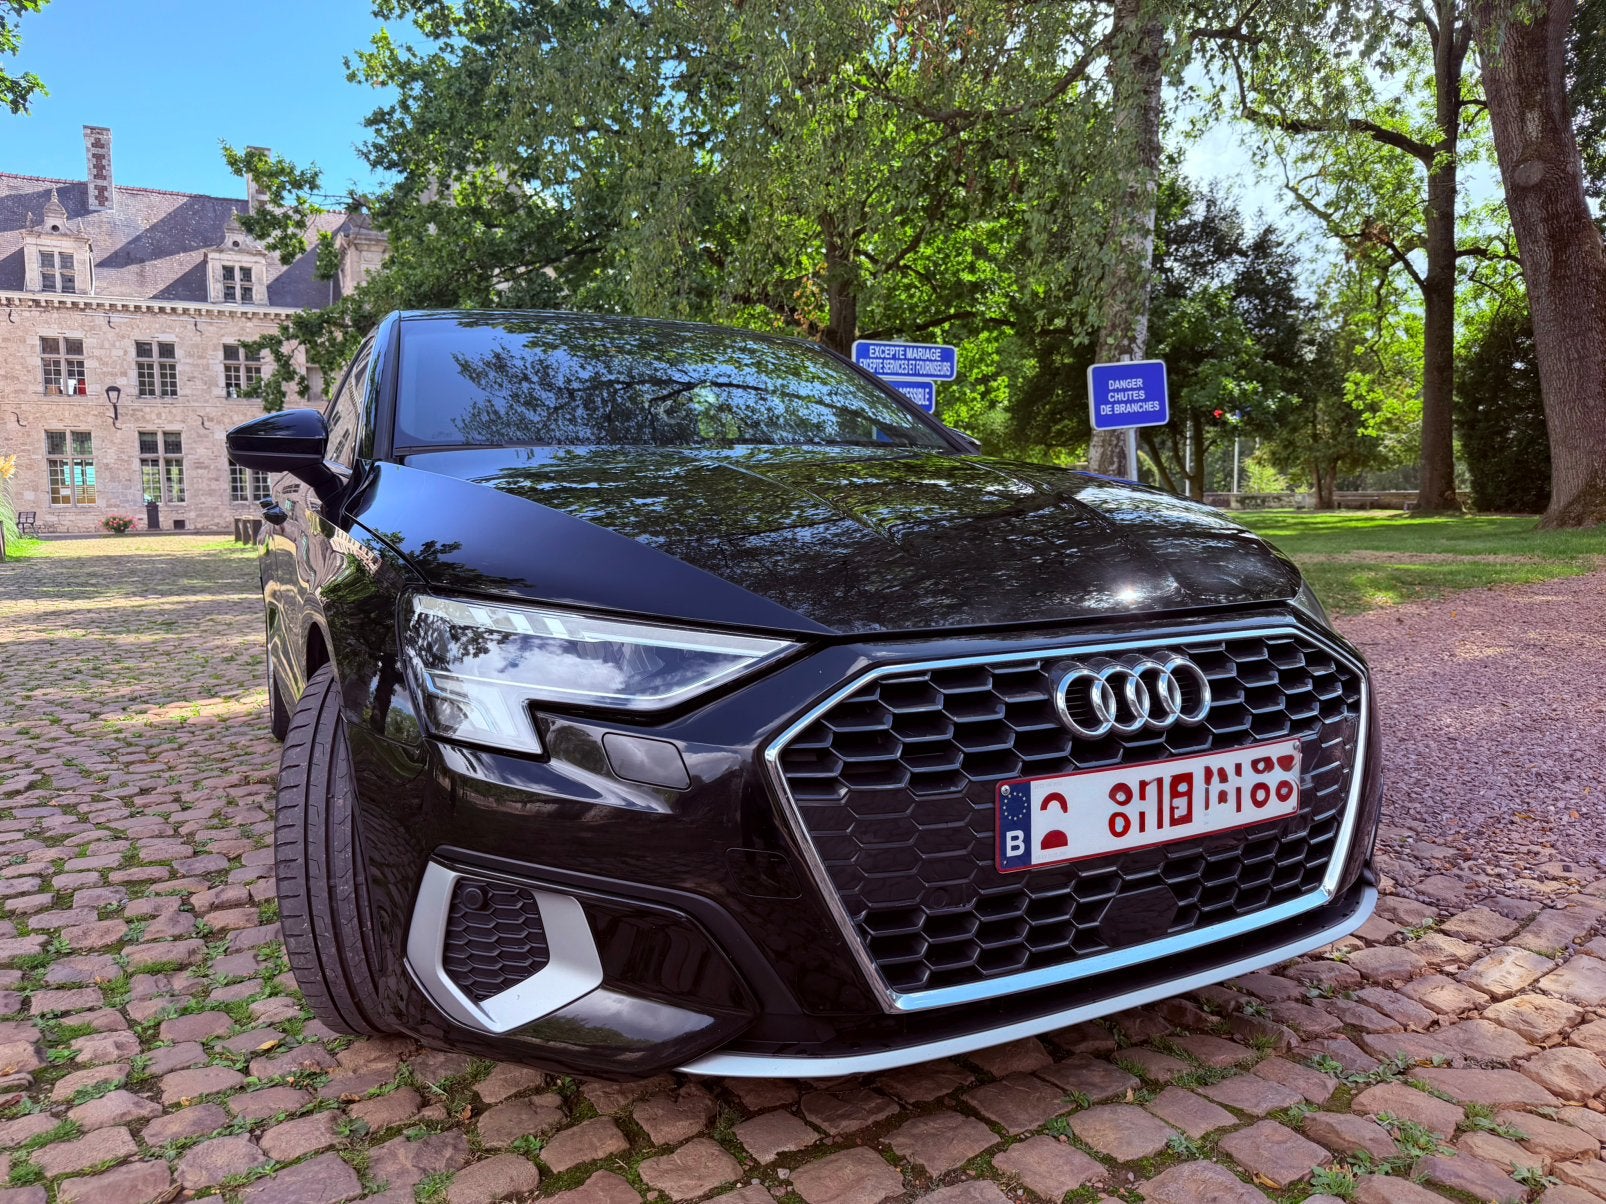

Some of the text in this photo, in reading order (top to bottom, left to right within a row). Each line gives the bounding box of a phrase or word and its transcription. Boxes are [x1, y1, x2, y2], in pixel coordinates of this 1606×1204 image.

[869, 346, 941, 360] EXCEPTE MARIAGE
[884, 361, 908, 373] SERVICES
[909, 362, 915, 374] ET
[1108, 379, 1143, 390] DANGER
[1108, 391, 1145, 402] CHUTES
[1100, 401, 1160, 415] DE BRANCHES
[1006, 830, 1025, 857] B
